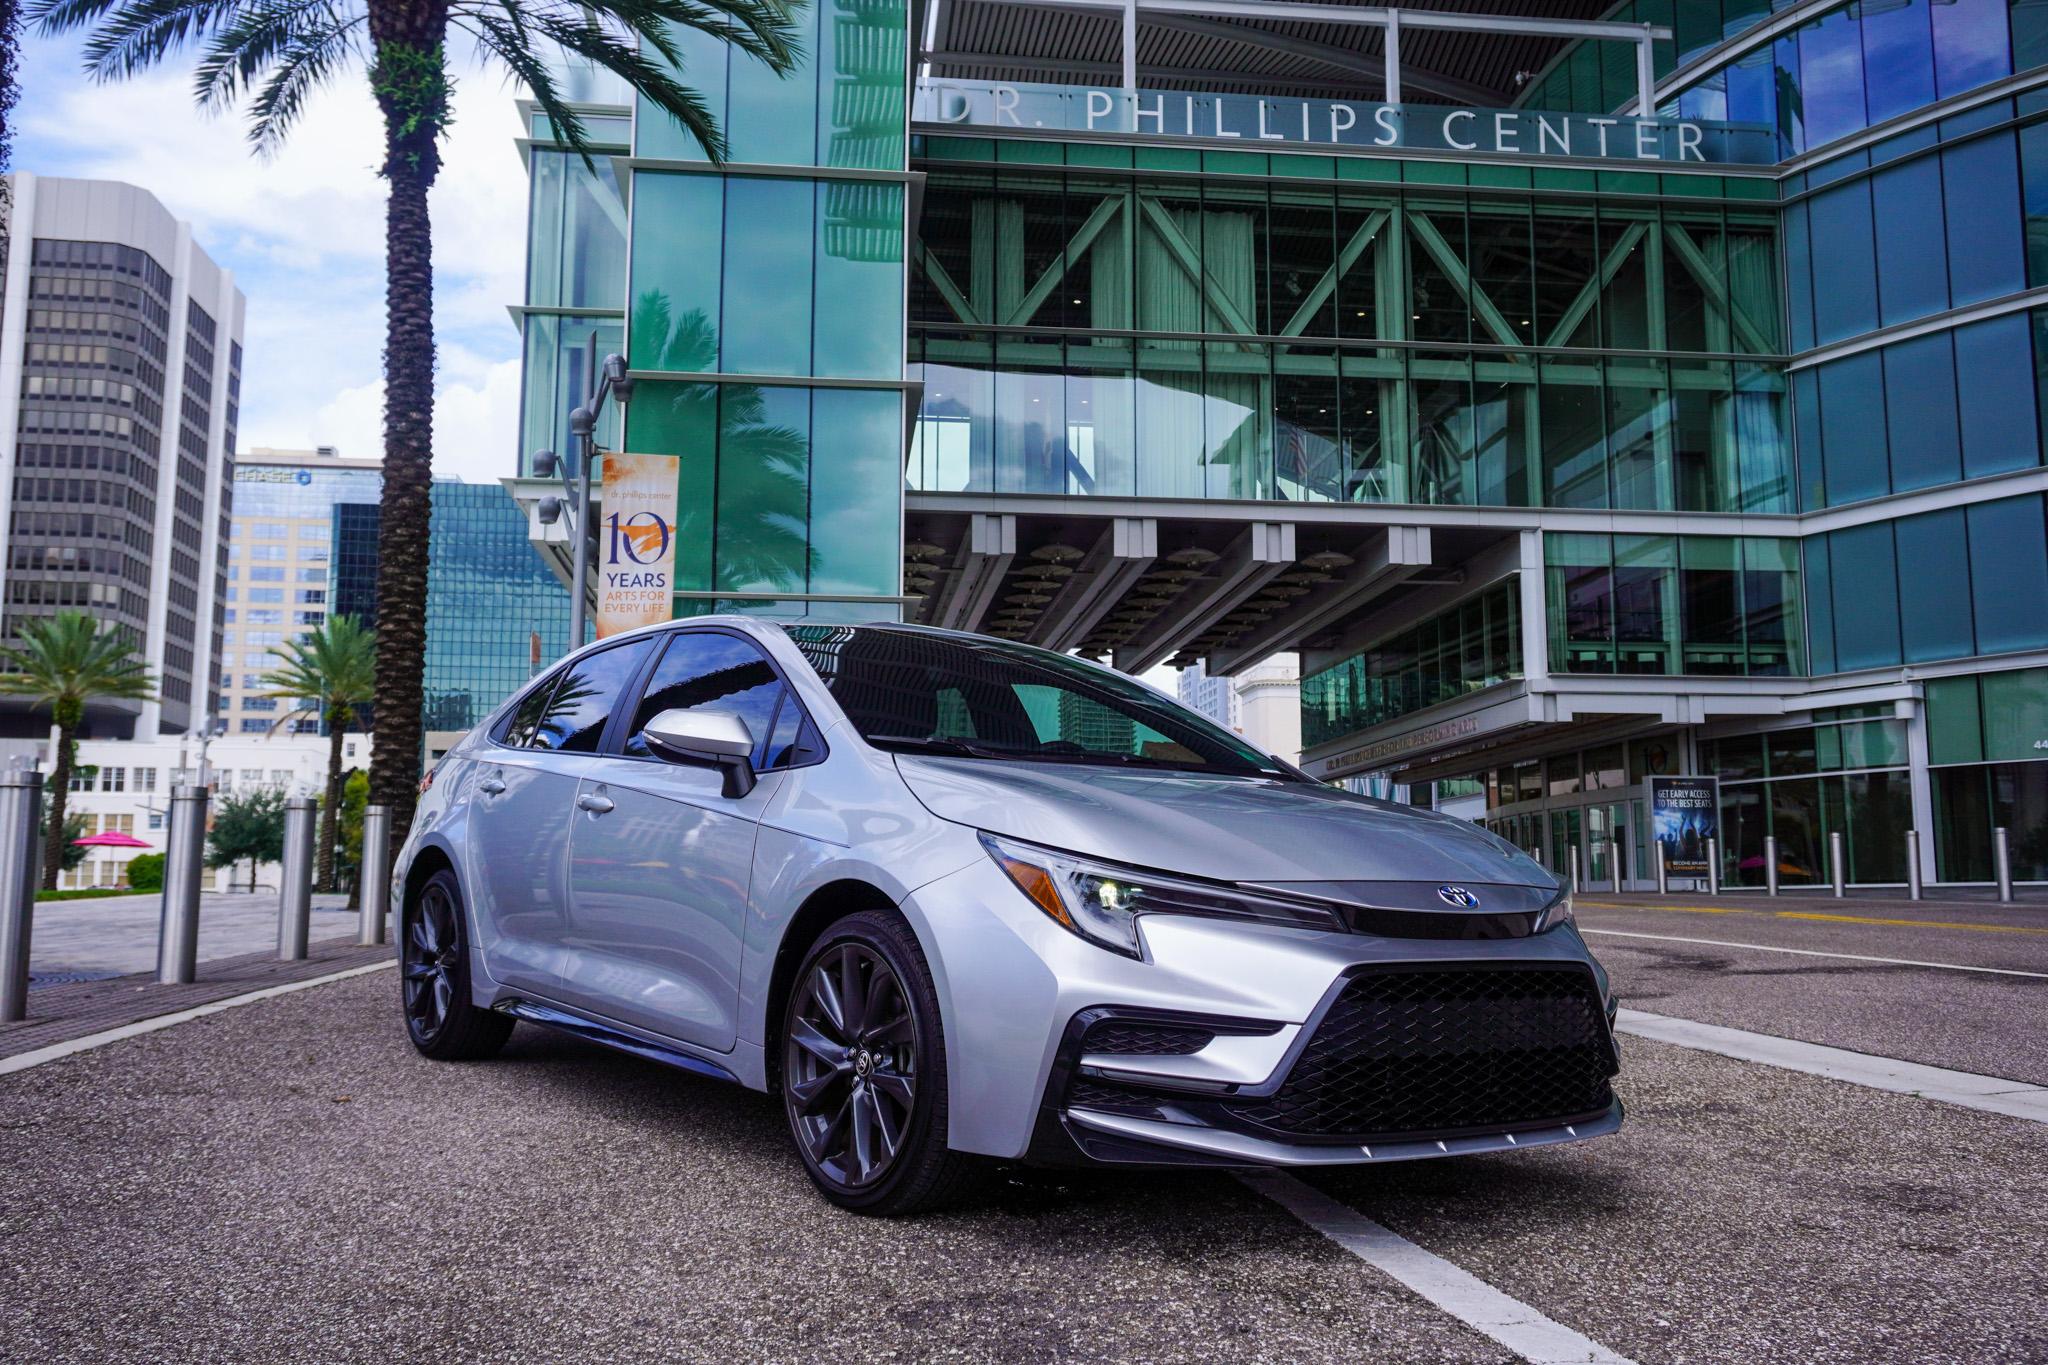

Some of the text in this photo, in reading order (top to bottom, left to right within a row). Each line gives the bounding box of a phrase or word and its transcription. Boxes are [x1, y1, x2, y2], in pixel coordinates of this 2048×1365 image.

[937, 83, 1706, 162] DR. PHILLIPS CENTER
[622, 489, 647, 500] phillips
[606, 511, 669, 565] 10
[607, 572, 666, 588] YEARS
[606, 591, 665, 601] ARTS FOR
[604, 603, 665, 613] EVERY LIFE
[1657, 789, 1711, 798] GET EARLY ACCESS
[1657, 799, 1712, 808] TO THE BEST SEATS
